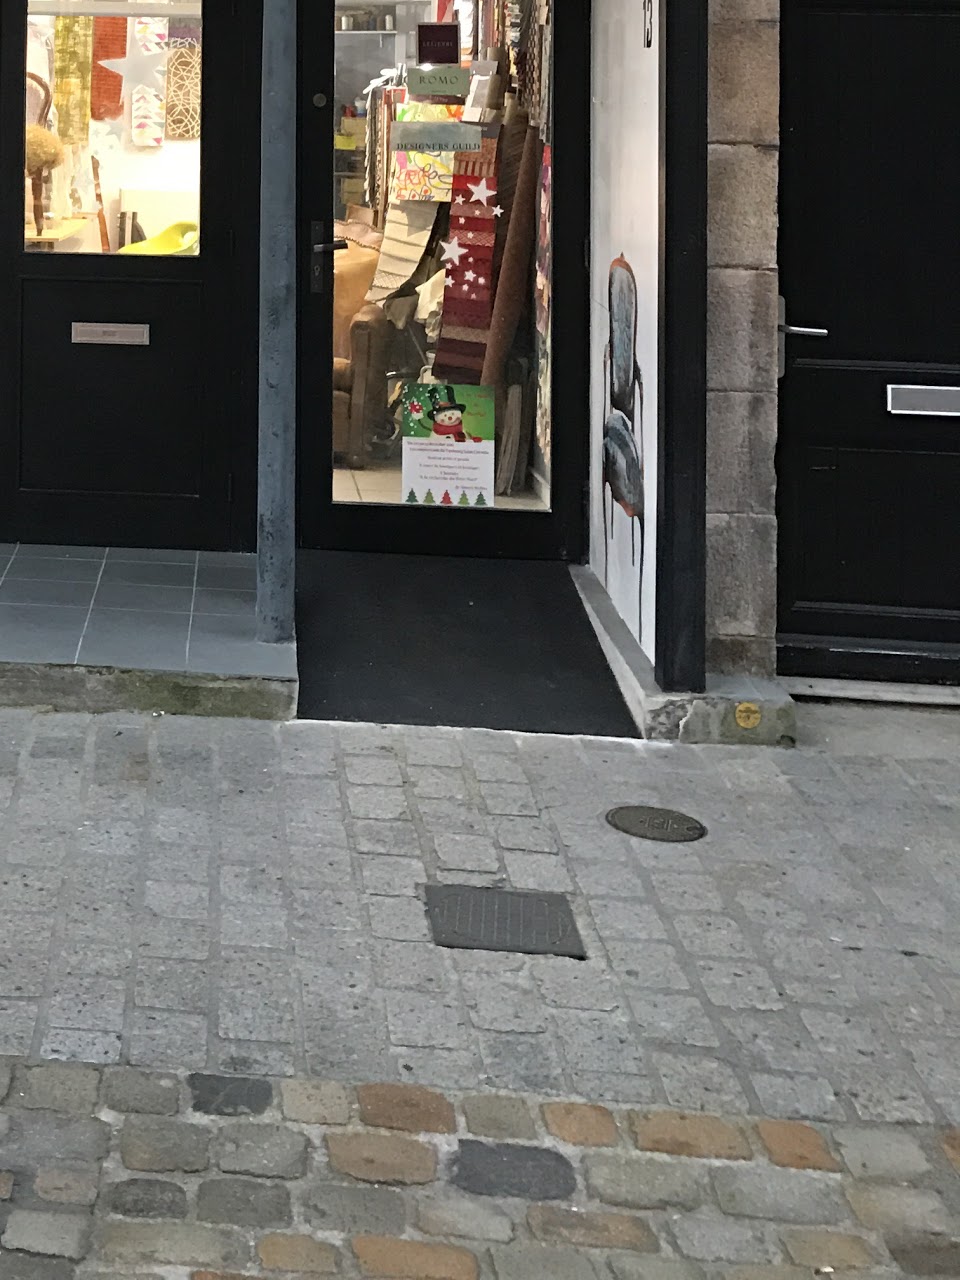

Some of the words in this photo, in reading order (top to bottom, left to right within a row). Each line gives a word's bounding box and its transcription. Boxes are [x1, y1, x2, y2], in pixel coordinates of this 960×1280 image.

[419, 75, 459, 85] ROMO
[397, 143, 449, 151] DESIGNERS
[452, 143, 481, 151] GUILD
